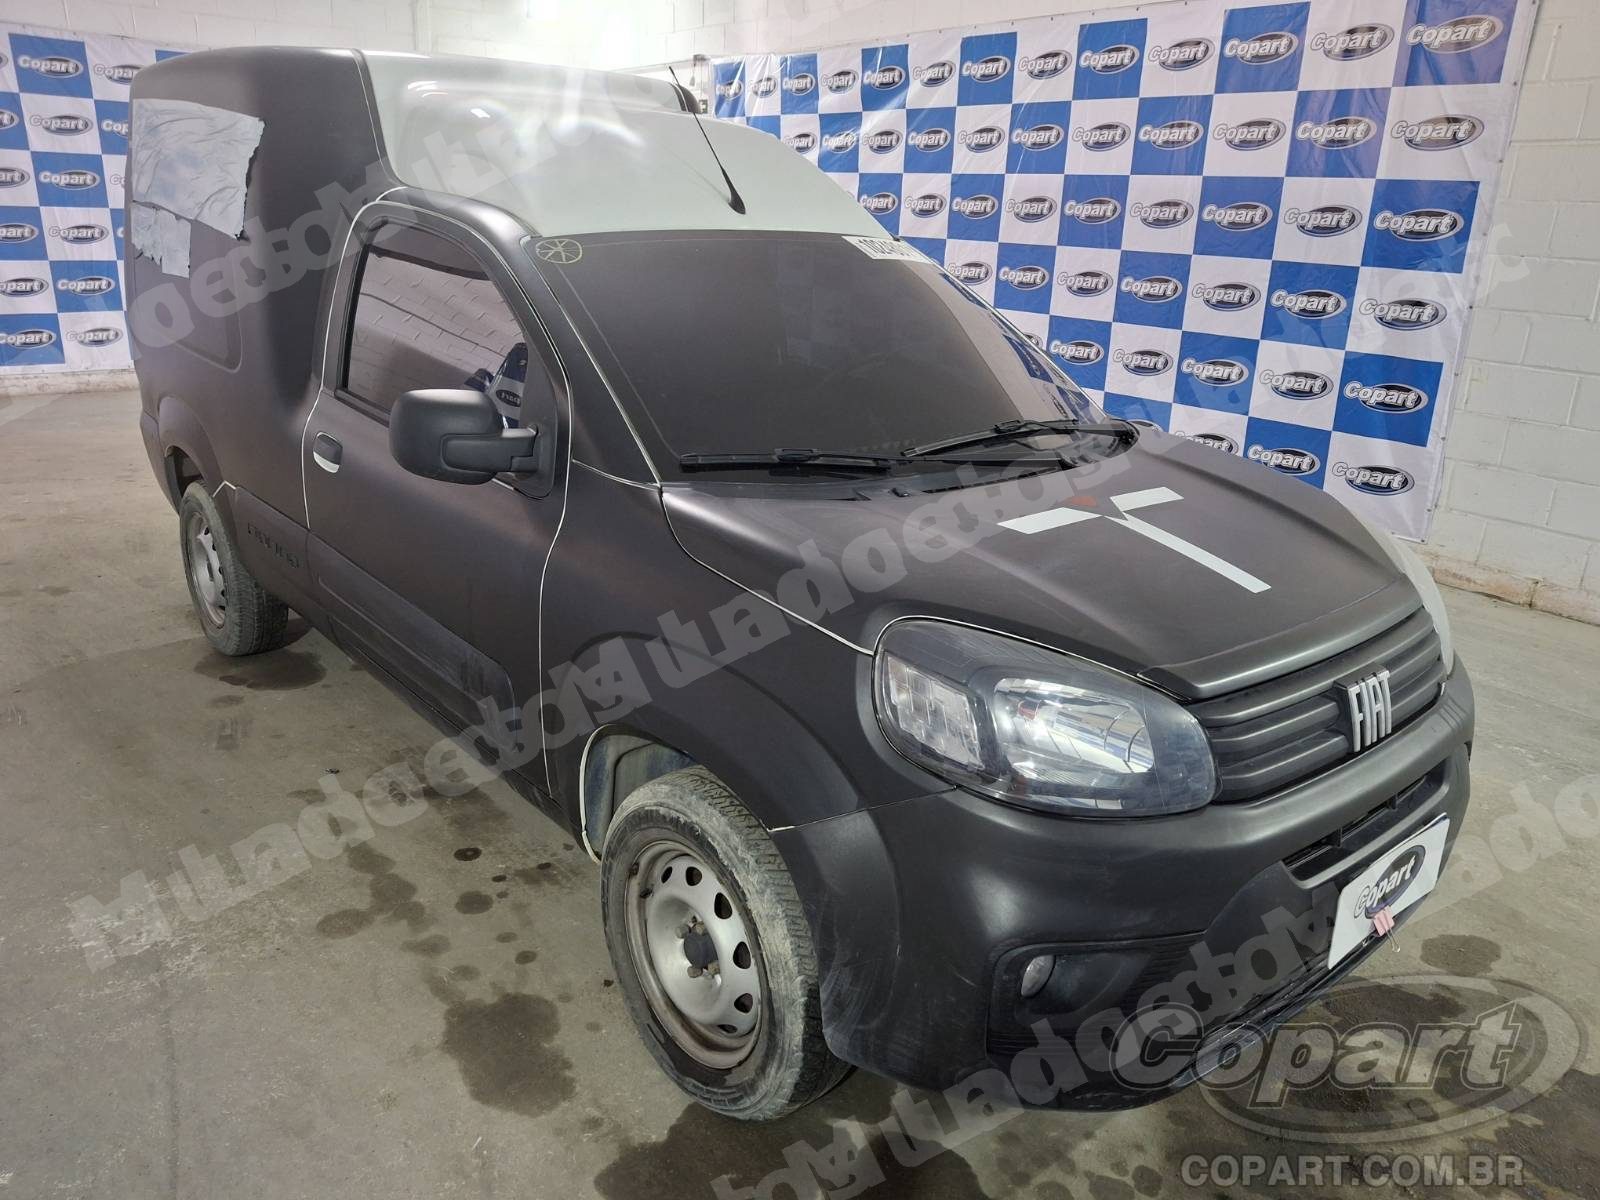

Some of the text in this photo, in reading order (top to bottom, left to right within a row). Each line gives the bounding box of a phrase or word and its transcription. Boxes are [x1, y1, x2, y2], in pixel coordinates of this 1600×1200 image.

[1310, 29, 1382, 51] Copart
[1407, 17, 1492, 48] Copart
[1149, 45, 1206, 66] Copart
[1225, 36, 1290, 58] Copart
[18, 55, 77, 73] Copart
[1018, 54, 1066, 74] Copart
[1079, 49, 1132, 68] Copart
[863, 69, 899, 88] Copart
[913, 64, 950, 81] Copart
[962, 60, 1004, 78] Copart
[783, 77, 811, 92] Copart
[822, 75, 854, 92] Copart
[30, 115, 86, 129] Copart
[908, 131, 945, 149] Copart
[958, 130, 998, 148] Copart
[1012, 128, 1057, 146] Copart
[1072, 126, 1122, 145] Copart
[1138, 124, 1197, 145] Copart
[1212, 123, 1276, 146] Copart
[1296, 121, 1369, 143] Copart
[1390, 120, 1473, 144] Copart
[863, 134, 897, 150] Copart
[39, 171, 93, 187] Copart
[859, 194, 893, 210] Copart
[904, 196, 941, 214] Copart
[952, 197, 992, 216] Copart
[1006, 199, 1050, 217] Copart
[1064, 200, 1115, 219] Copart
[1130, 202, 1187, 221] Copart
[1202, 203, 1268, 226] Copart
[1284, 208, 1351, 228] Copart
[1374, 210, 1454, 234] Copart
[48, 226, 100, 240] Copart
[948, 262, 986, 281] Copart
[1000, 266, 1043, 285] Copart
[1057, 272, 1105, 290] Copart
[57, 279, 107, 293] Copart
[1121, 276, 1174, 297] Copart
[1191, 283, 1251, 304] Copart
[1271, 289, 1339, 313] Copart
[1359, 298, 1436, 323] Copart
[65, 329, 117, 343] Copart
[1050, 340, 1098, 360] Copart
[1112, 348, 1165, 370] Copart
[1181, 357, 1245, 380] Copart
[1260, 369, 1327, 394] Copart
[1343, 381, 1422, 409] Copart
[1247, 444, 1316, 472] Copart
[1331, 461, 1405, 490] Copart
[1347, 670, 1392, 753] FIAT
[1353, 855, 1417, 919] Copart
